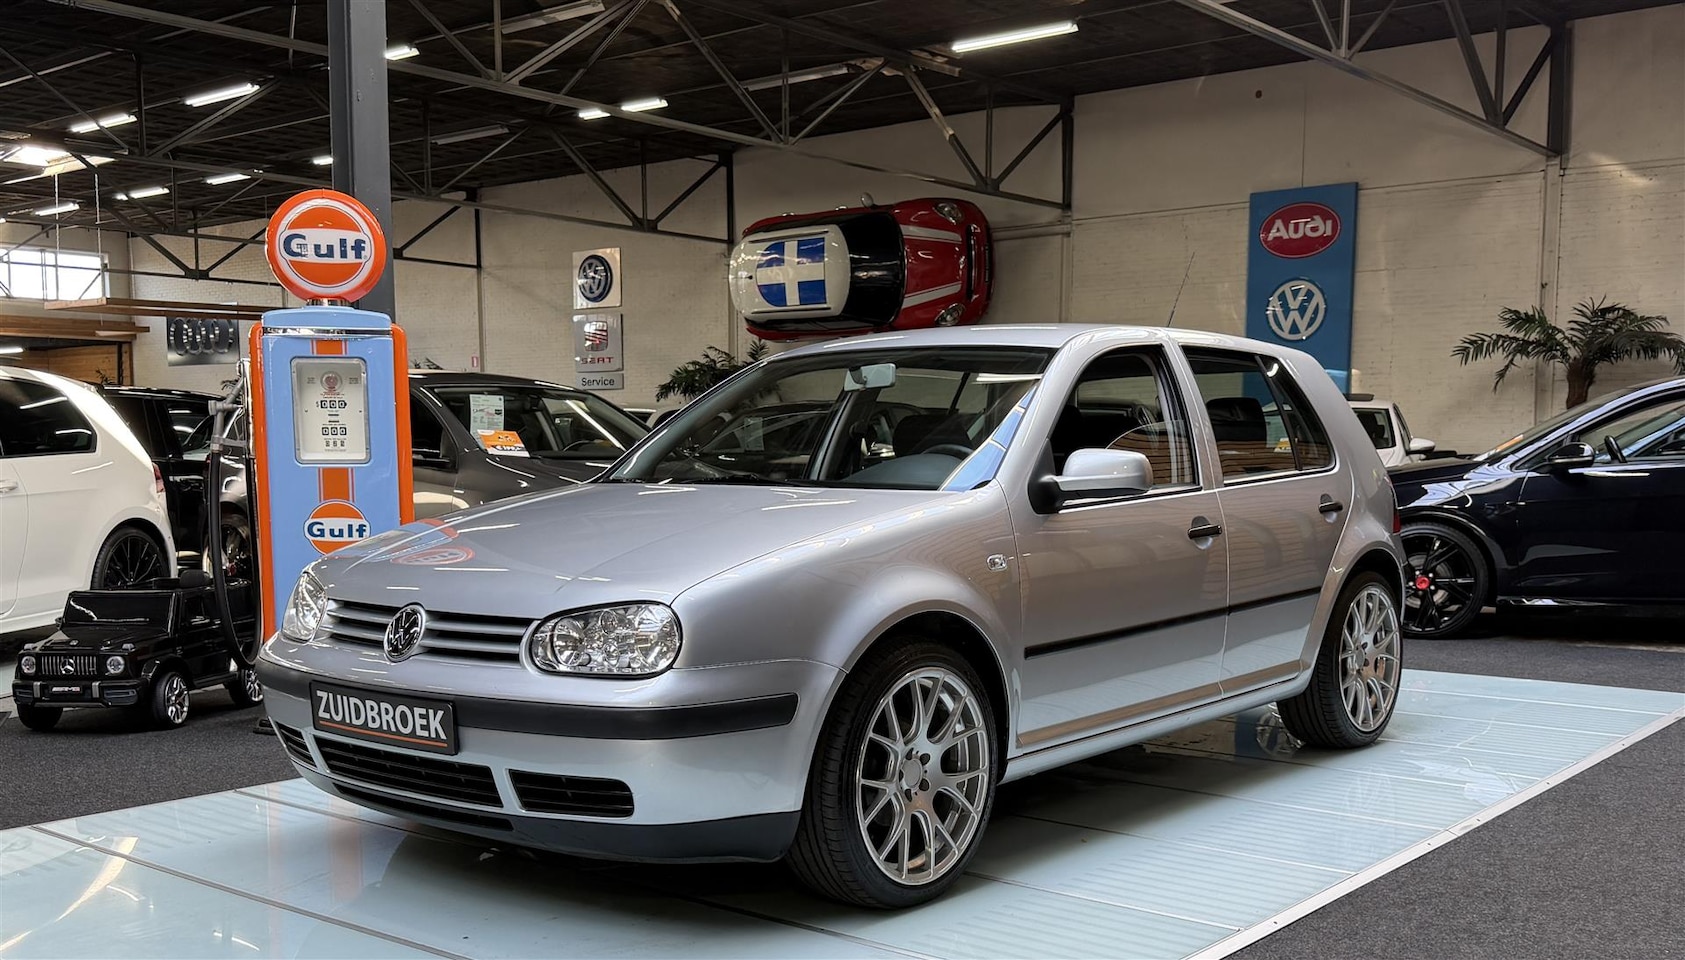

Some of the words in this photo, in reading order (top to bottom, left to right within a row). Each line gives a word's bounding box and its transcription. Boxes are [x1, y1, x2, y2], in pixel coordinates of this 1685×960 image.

[283, 233, 366, 259] Gulf
[581, 377, 615, 386] Service
[307, 521, 367, 538] Gulf
[316, 690, 447, 740] ZUIDBROEK
